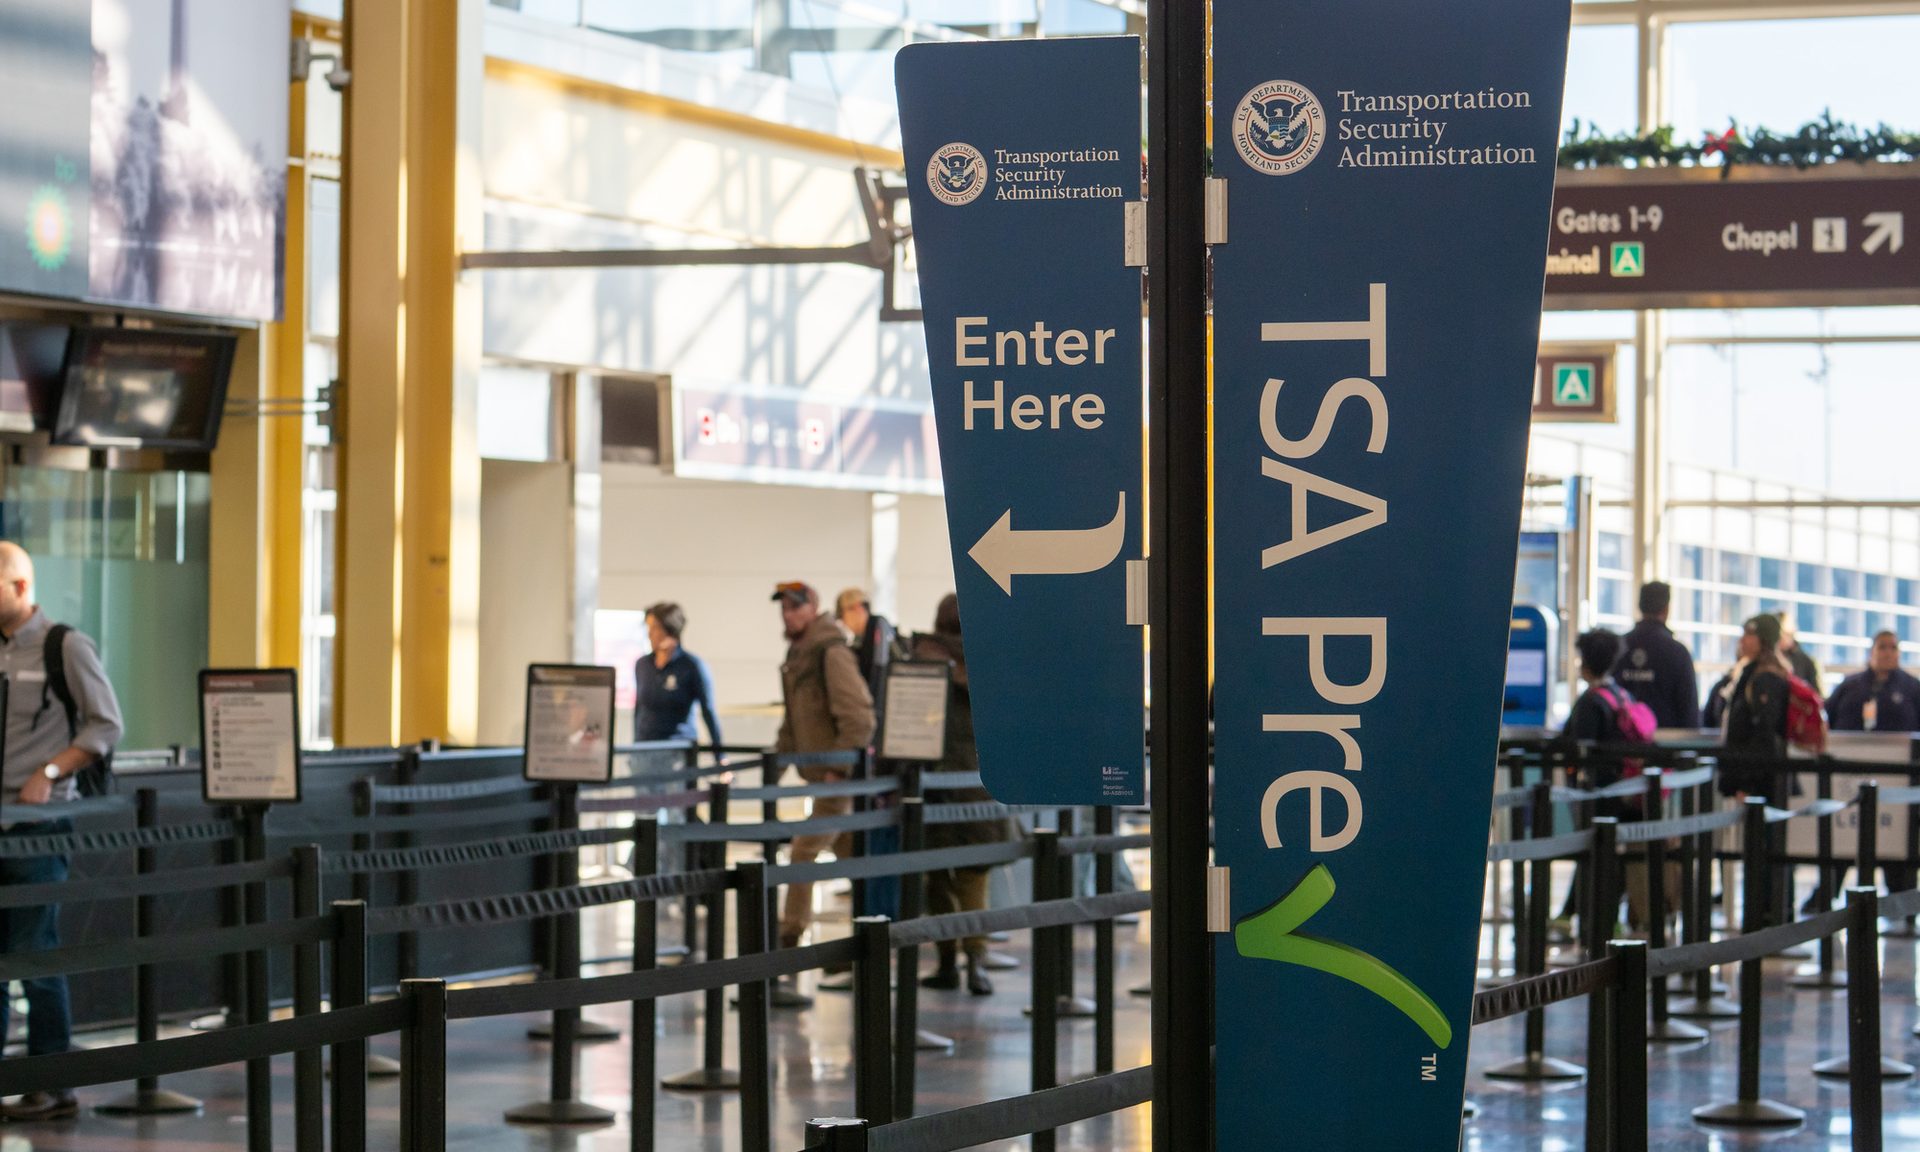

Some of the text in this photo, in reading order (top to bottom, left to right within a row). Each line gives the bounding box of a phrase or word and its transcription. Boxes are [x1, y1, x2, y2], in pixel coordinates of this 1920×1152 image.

[1252, 85, 1314, 107] DEPARTMENT
[1311, 107, 1320, 121] OF
[1337, 87, 1532, 118] Transportation
[1338, 117, 1447, 145] Security
[939, 145, 980, 160] DEPARTMENT
[977, 160, 985, 169] OF
[994, 147, 1120, 167] Transportation
[1238, 131, 1321, 171] HOMELAND SECURITY
[1337, 143, 1537, 168] Administration
[930, 176, 984, 203] HOMELAND SECURITY
[995, 167, 1066, 185] Security
[994, 184, 1123, 201] Administration
[1557, 204, 1663, 234] Gates 1-9
[1721, 220, 1799, 257] Chapel
[1546, 245, 1640, 275] minal A
[955, 316, 1116, 366] Enter
[1560, 368, 1589, 402] A
[964, 380, 1106, 430] Here
[1259, 283, 1389, 852] TSA Pre
